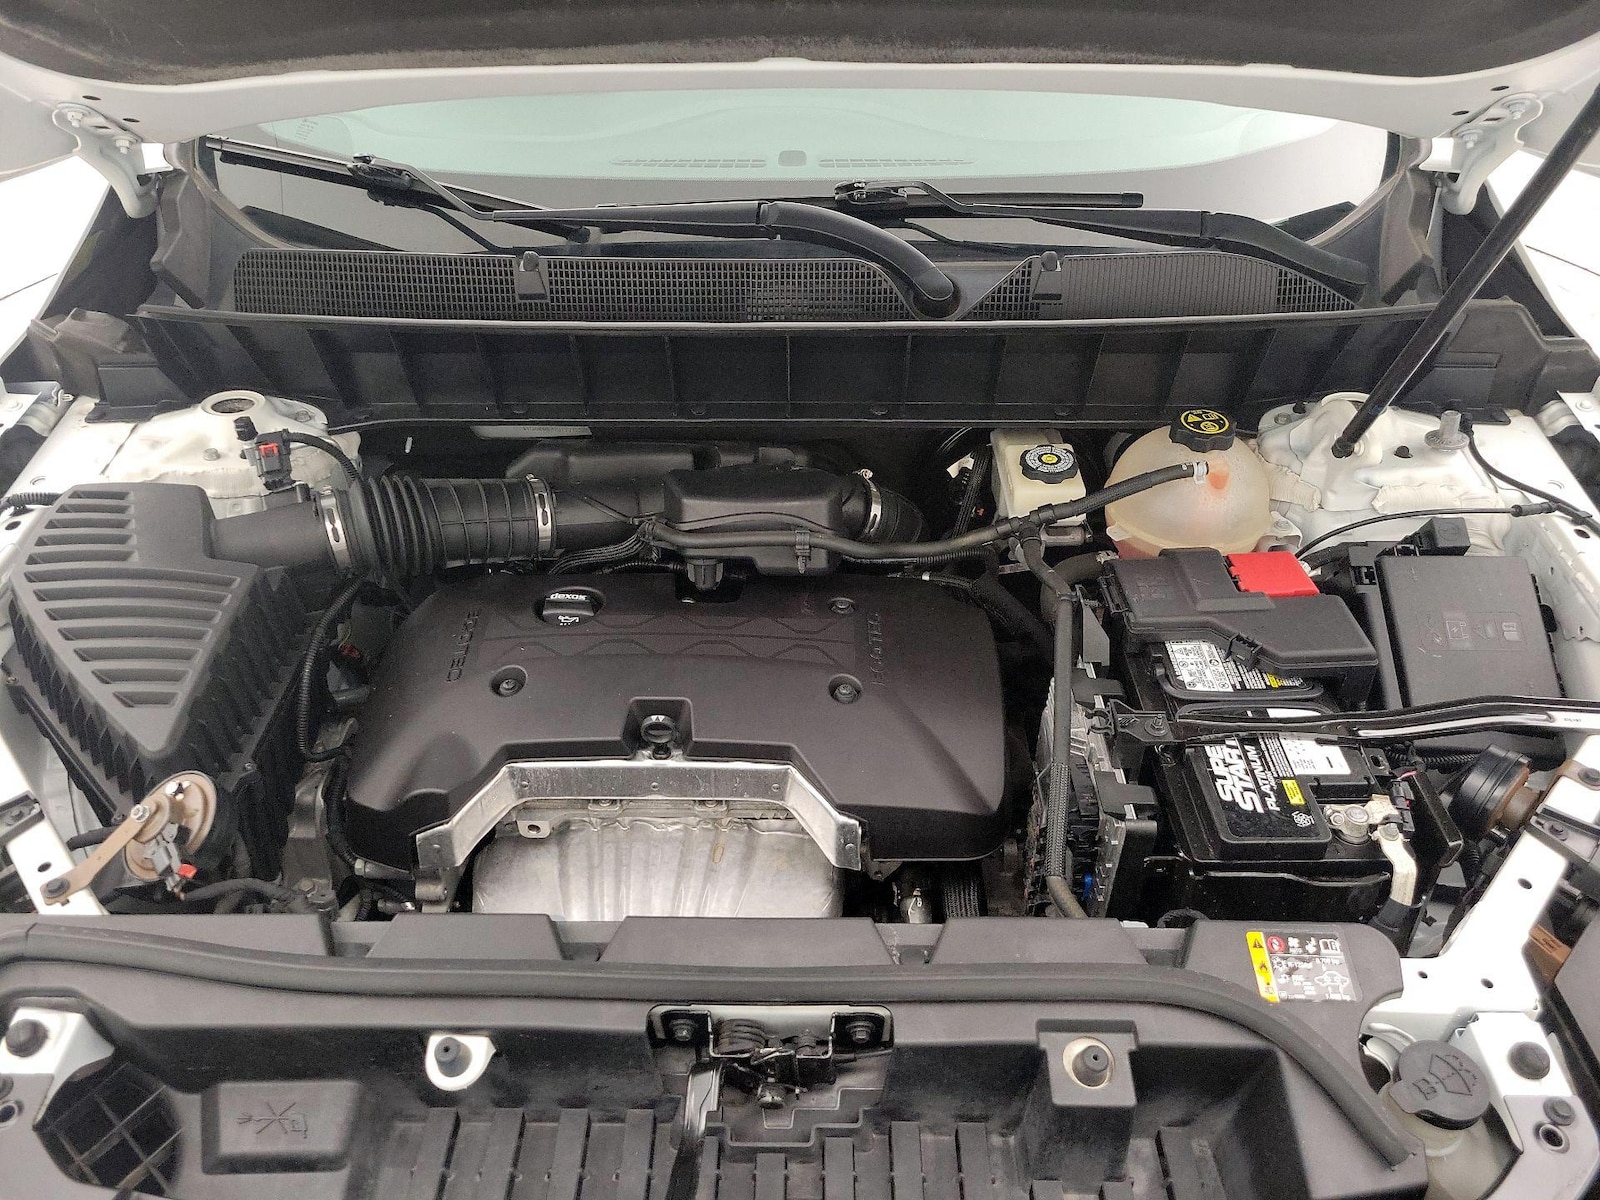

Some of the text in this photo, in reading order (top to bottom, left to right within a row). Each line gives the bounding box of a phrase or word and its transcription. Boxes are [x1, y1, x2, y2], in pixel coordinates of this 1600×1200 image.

[550, 592, 588, 601] dexos
[1203, 744, 1234, 802] SUPE
[1243, 744, 1281, 812] PLATINUM
